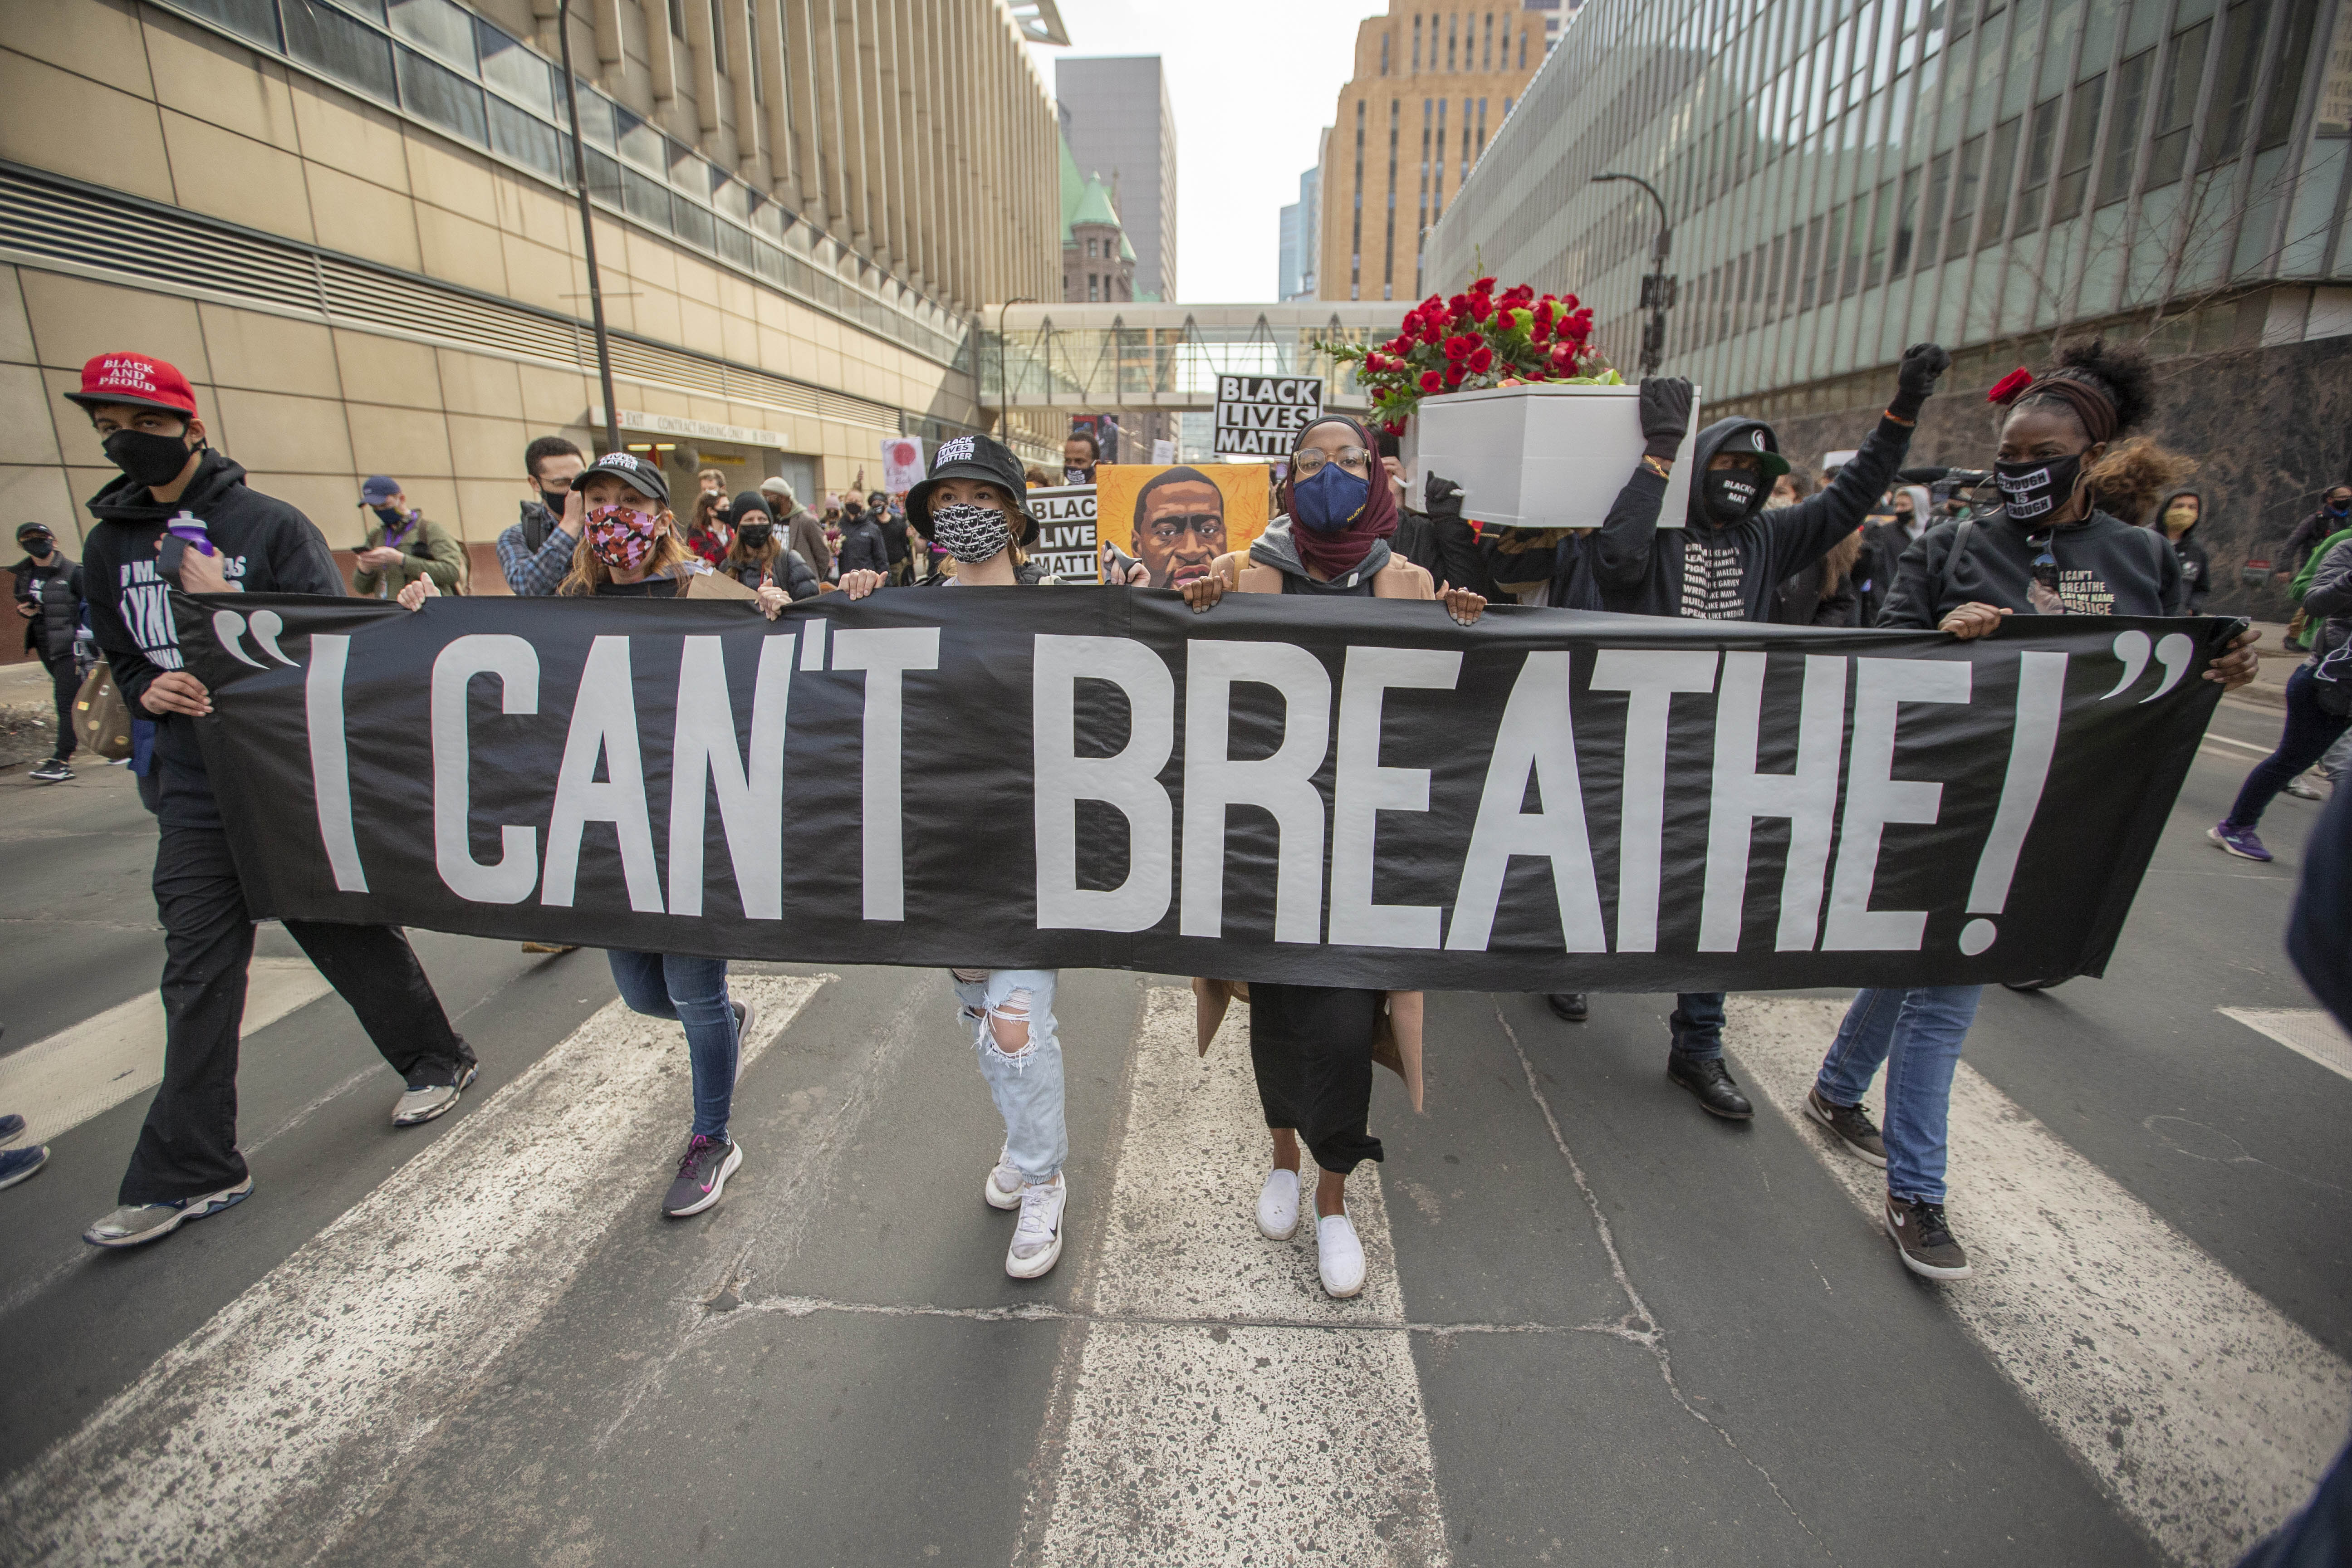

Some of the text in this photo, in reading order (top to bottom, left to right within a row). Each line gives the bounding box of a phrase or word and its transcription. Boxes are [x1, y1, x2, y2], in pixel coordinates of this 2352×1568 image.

[103, 359, 155, 374] BLACK
[110, 368, 145, 380] AND
[98, 377, 157, 392] PROUD
[1222, 377, 1318, 405] BLACK
[1226, 404, 1309, 429] LIVES
[1216, 428, 1298, 454] MATTE
[940, 444, 969, 458] LIVES
[598, 460, 637, 472] MATTER
[936, 453, 972, 469] MATTER
[1723, 480, 1751, 493] BLACK
[2015, 492, 2029, 503] IS
[1032, 498, 1097, 519] BLAC
[1039, 525, 1096, 549] LIVE
[1035, 554, 1098, 575] MATT
[1685, 554, 1705, 563] LEA
[1685, 563, 1705, 574] FIGH
[1717, 568, 1743, 578] MALCOLM
[2059, 570, 2092, 581] I CAN'T
[1718, 578, 1740, 588] GARVEY
[2059, 582, 2106, 593] BREATHE
[1683, 584, 1706, 598] WRITE
[1720, 589, 1737, 598] MAYA
[2091, 593, 2116, 603] NAME
[1682, 595, 1705, 608] BUILD
[1681, 607, 1707, 619] SPEAK
[431, 618, 941, 921] CAN'T
